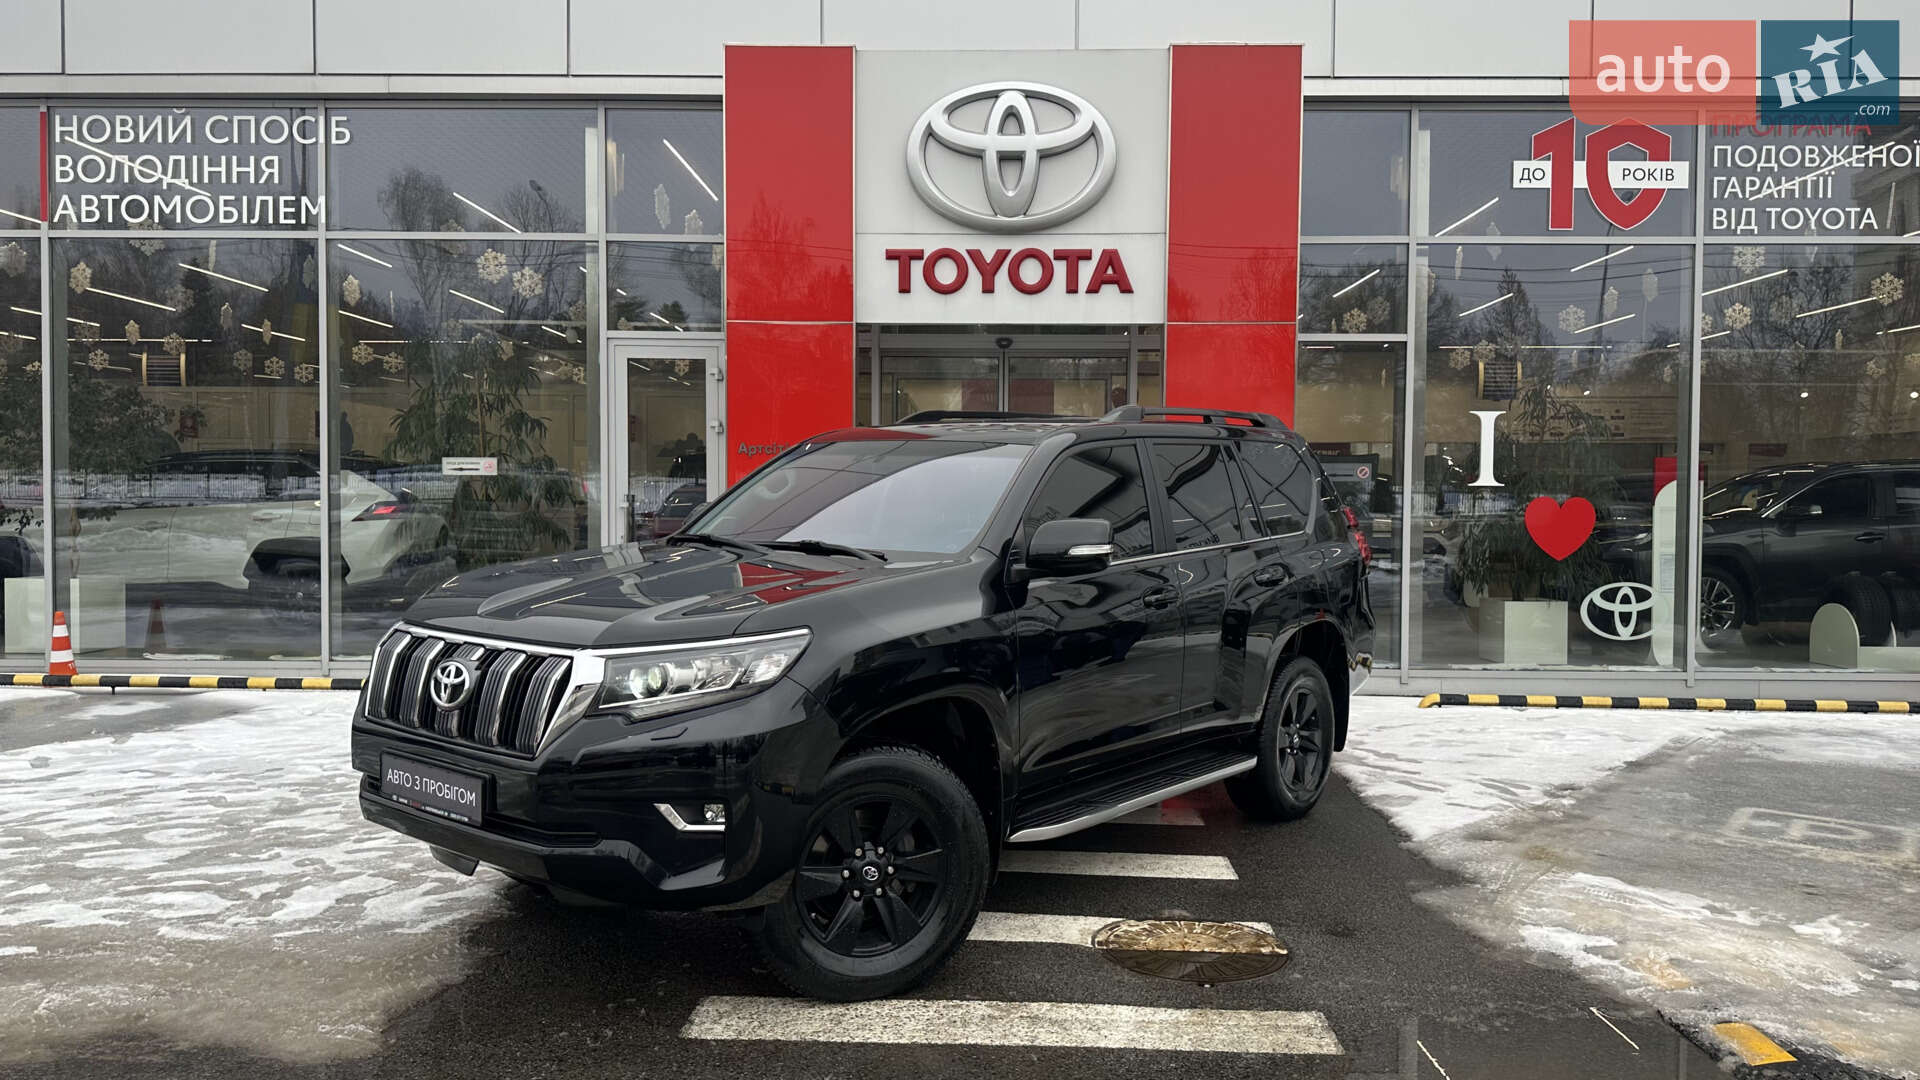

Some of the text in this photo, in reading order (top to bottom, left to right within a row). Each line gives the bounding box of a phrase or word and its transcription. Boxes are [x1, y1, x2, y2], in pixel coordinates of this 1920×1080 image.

[54, 107, 352, 145] НОВИЙ СПОСІБ
[54, 154, 280, 189] ВОЛОДІННЯ
[1712, 138, 1920, 173] ПОДОВЖЕНОЇ
[1519, 167, 1546, 184] ДО
[1622, 166, 1676, 182] РОКІВ
[1712, 170, 1836, 199] ГАРАНТІЇ
[53, 193, 327, 225] АВТОМОБІЛЕМ
[1712, 207, 1758, 235] ВІД
[885, 247, 1134, 295] TOYOTA
[386, 768, 412, 788] АВТО
[422, 777, 476, 807] ПРОБІГОМ
